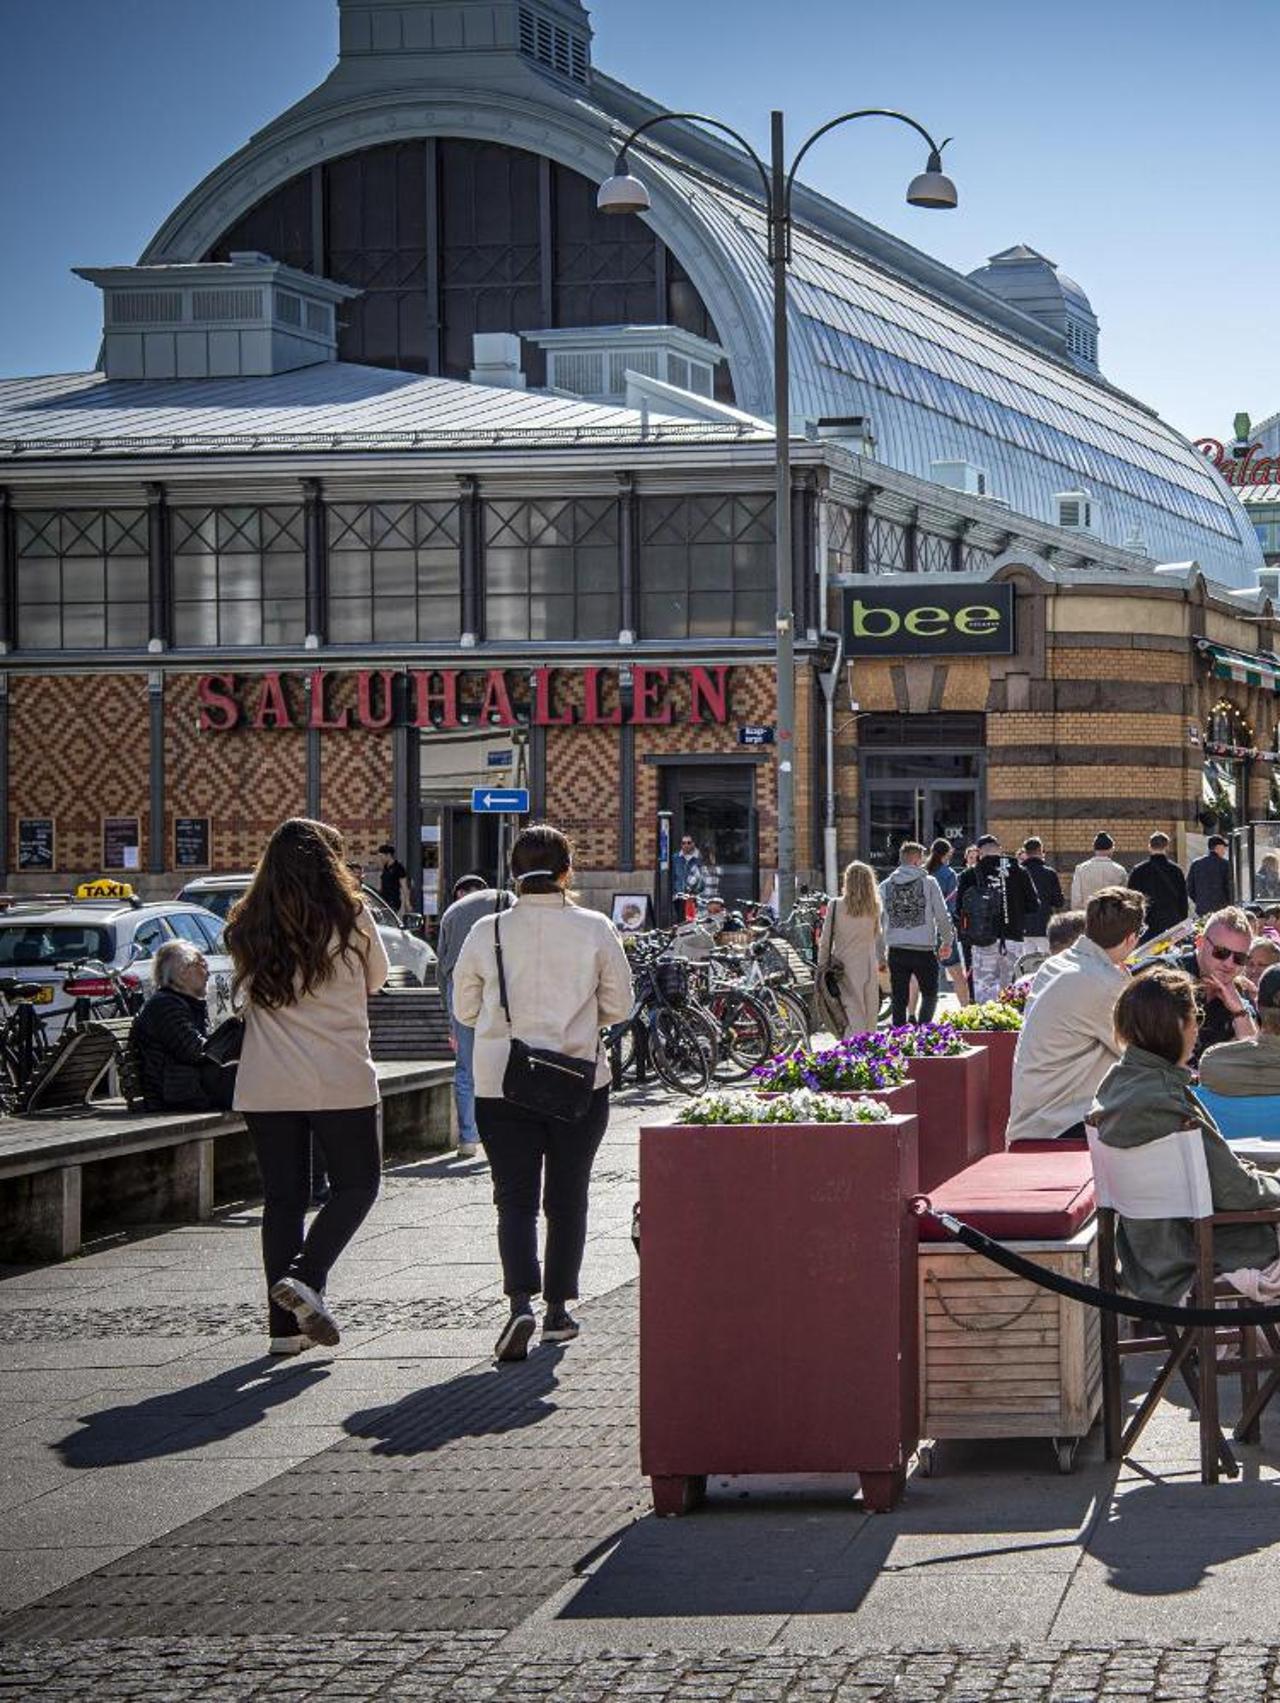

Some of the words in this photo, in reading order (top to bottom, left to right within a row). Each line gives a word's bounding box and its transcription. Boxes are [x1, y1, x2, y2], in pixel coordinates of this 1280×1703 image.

[852, 599, 1001, 638] bee
[197, 664, 730, 731] SALUHALLEN
[83, 886, 125, 897] TAXI
